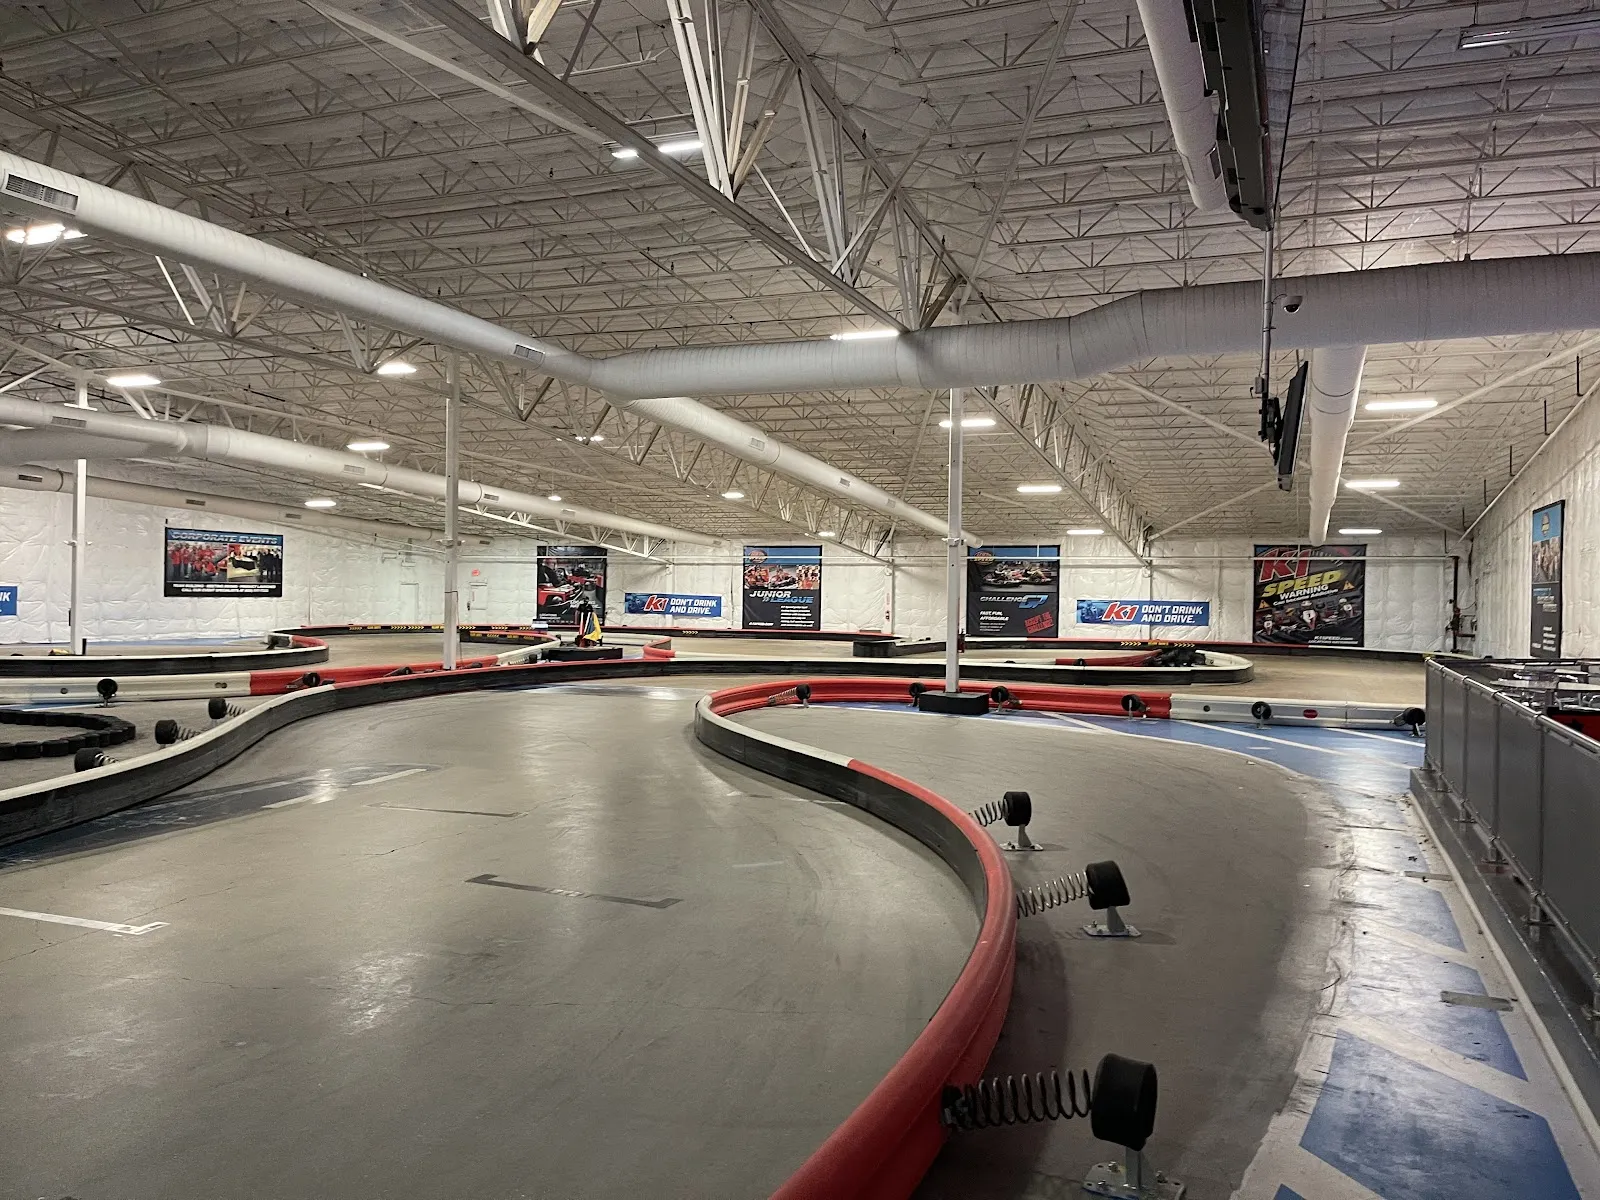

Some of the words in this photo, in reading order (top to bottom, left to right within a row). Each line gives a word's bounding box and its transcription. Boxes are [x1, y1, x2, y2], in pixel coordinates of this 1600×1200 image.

[172, 531, 237, 543] CORPORATE
[239, 535, 278, 544] EVENTS
[1259, 548, 1312, 582] K1
[1261, 570, 1343, 598] SPEED
[749, 590, 792, 598] JUNIOR
[1280, 584, 1329, 600] WARNING
[643, 595, 669, 611] K1
[670, 598, 694, 606] DON'T
[694, 599, 717, 607] DRINK
[770, 596, 814, 604] LEAGUE
[1101, 601, 1139, 621] K1
[1141, 605, 1171, 614] DON'T
[1171, 605, 1203, 615] DRINK
[1140, 614, 1164, 623] AND
[1164, 614, 1195, 624] DRIVE.
